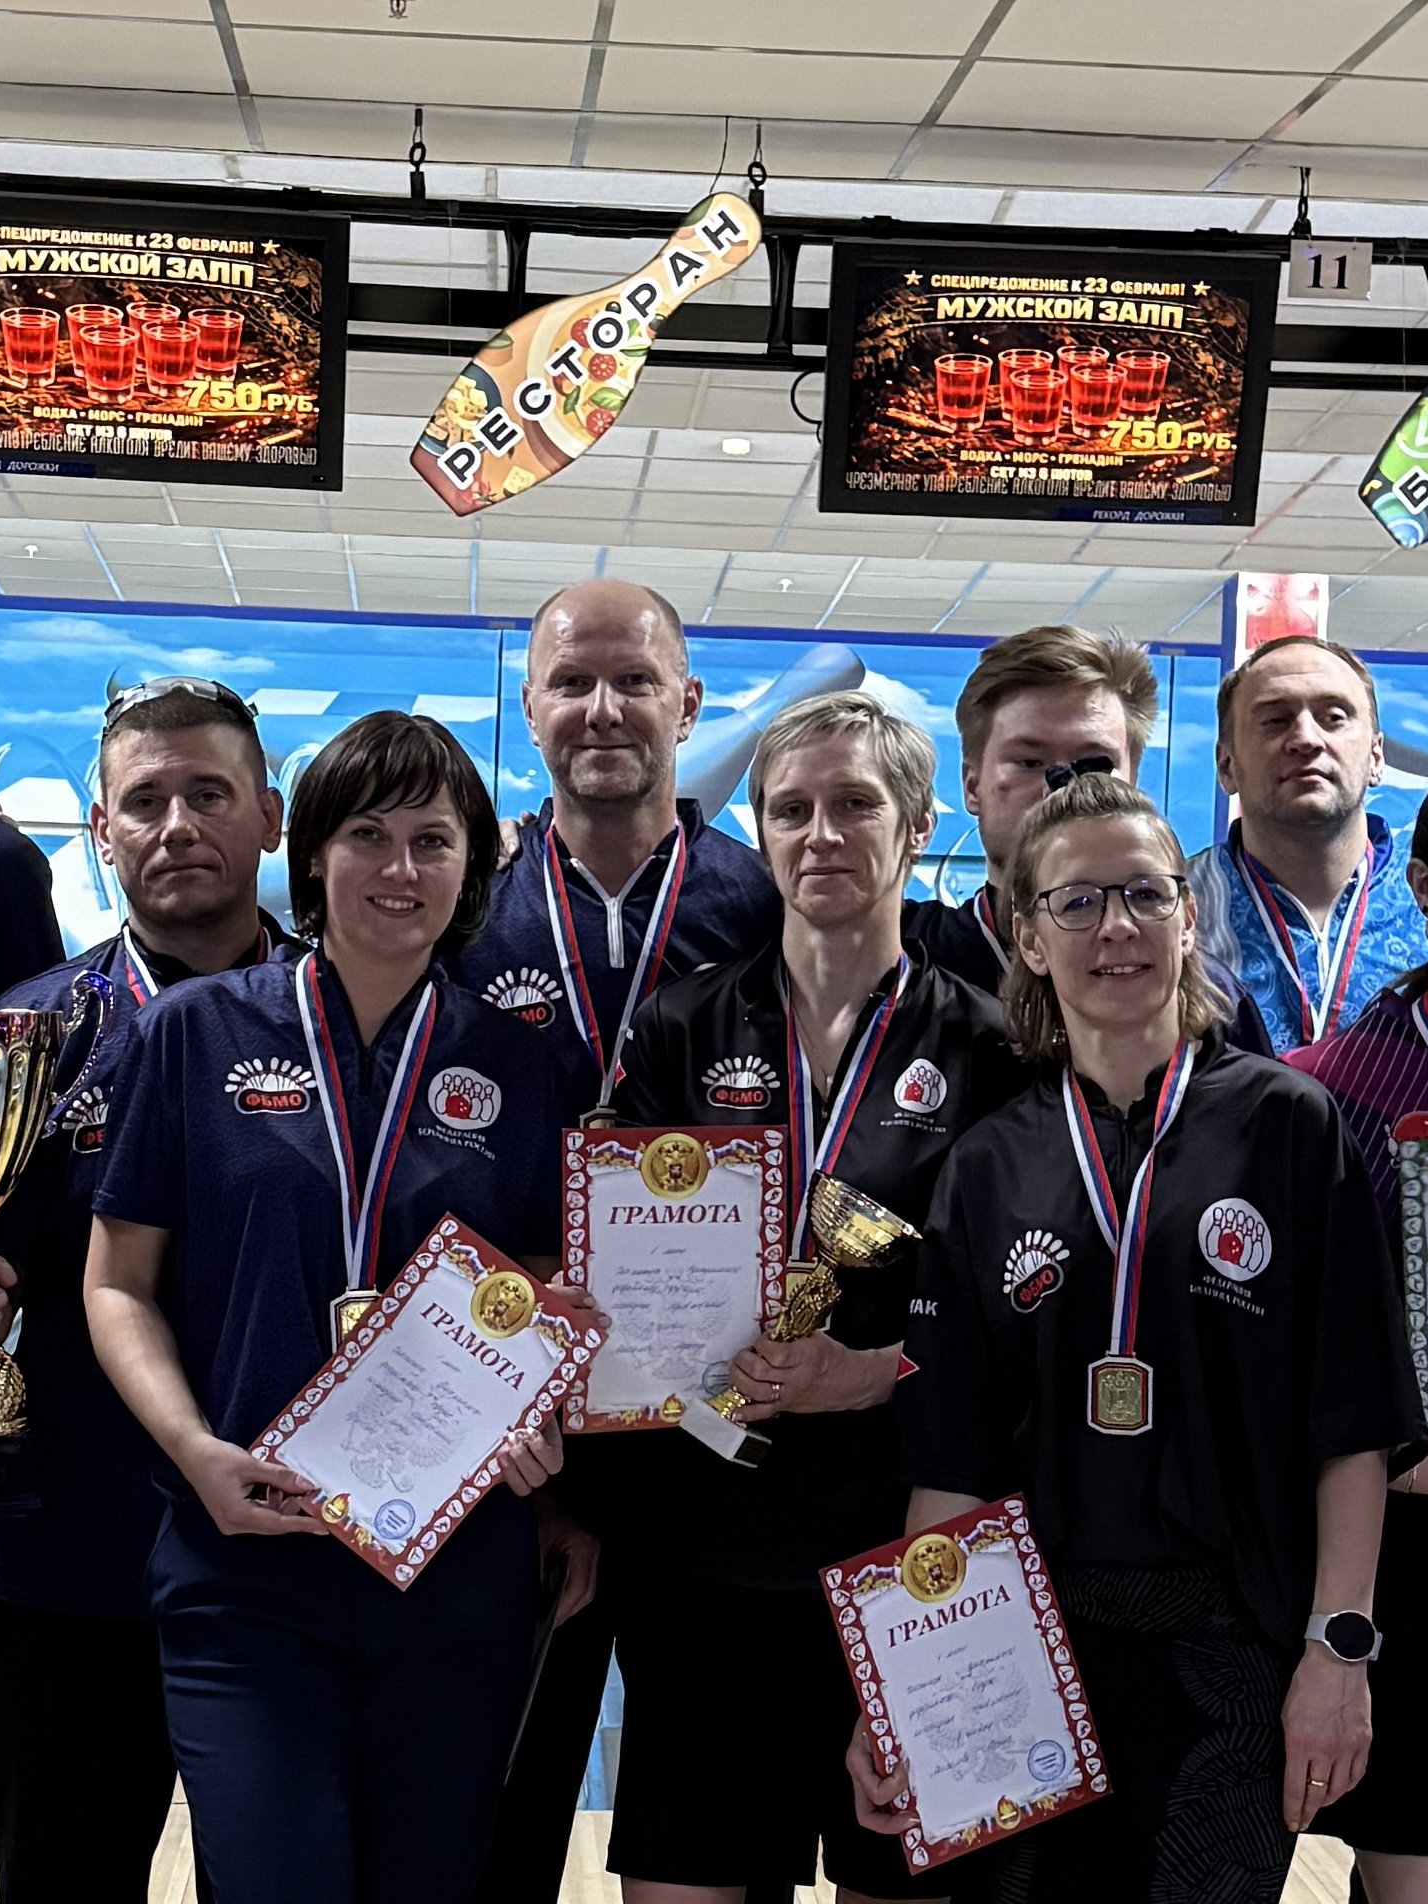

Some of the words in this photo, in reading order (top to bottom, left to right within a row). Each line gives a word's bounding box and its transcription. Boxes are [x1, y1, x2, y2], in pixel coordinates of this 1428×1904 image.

[136, 236, 146, 247] К
[150, 233, 173, 248] 23
[177, 237, 254, 254] ФЕВРАЛЯ!
[0, 250, 160, 277] МУЖСКОЙ
[166, 258, 254, 288] ЗАЛП
[1307, 253, 1350, 290] 11
[1072, 280, 1082, 292] К
[1085, 278, 1108, 293] 23
[1111, 281, 1185, 296] ФЕВРАЛЯ!
[937, 296, 1093, 320] МУЖСКОЙ
[1099, 301, 1183, 328] ЗАЛП
[443, 211, 740, 483] РЕСТОРАН
[185, 381, 262, 411] 750
[267, 394, 319, 413] РУБ.
[1107, 421, 1182, 450] 750
[1187, 432, 1237, 450] РУБ.
[245, 1093, 302, 1107] ФБМО
[607, 1204, 742, 1225] ГРАМОТА
[420, 1302, 526, 1391] ГРАМОТА
[885, 1583, 1013, 1649] ГРАМОТА
